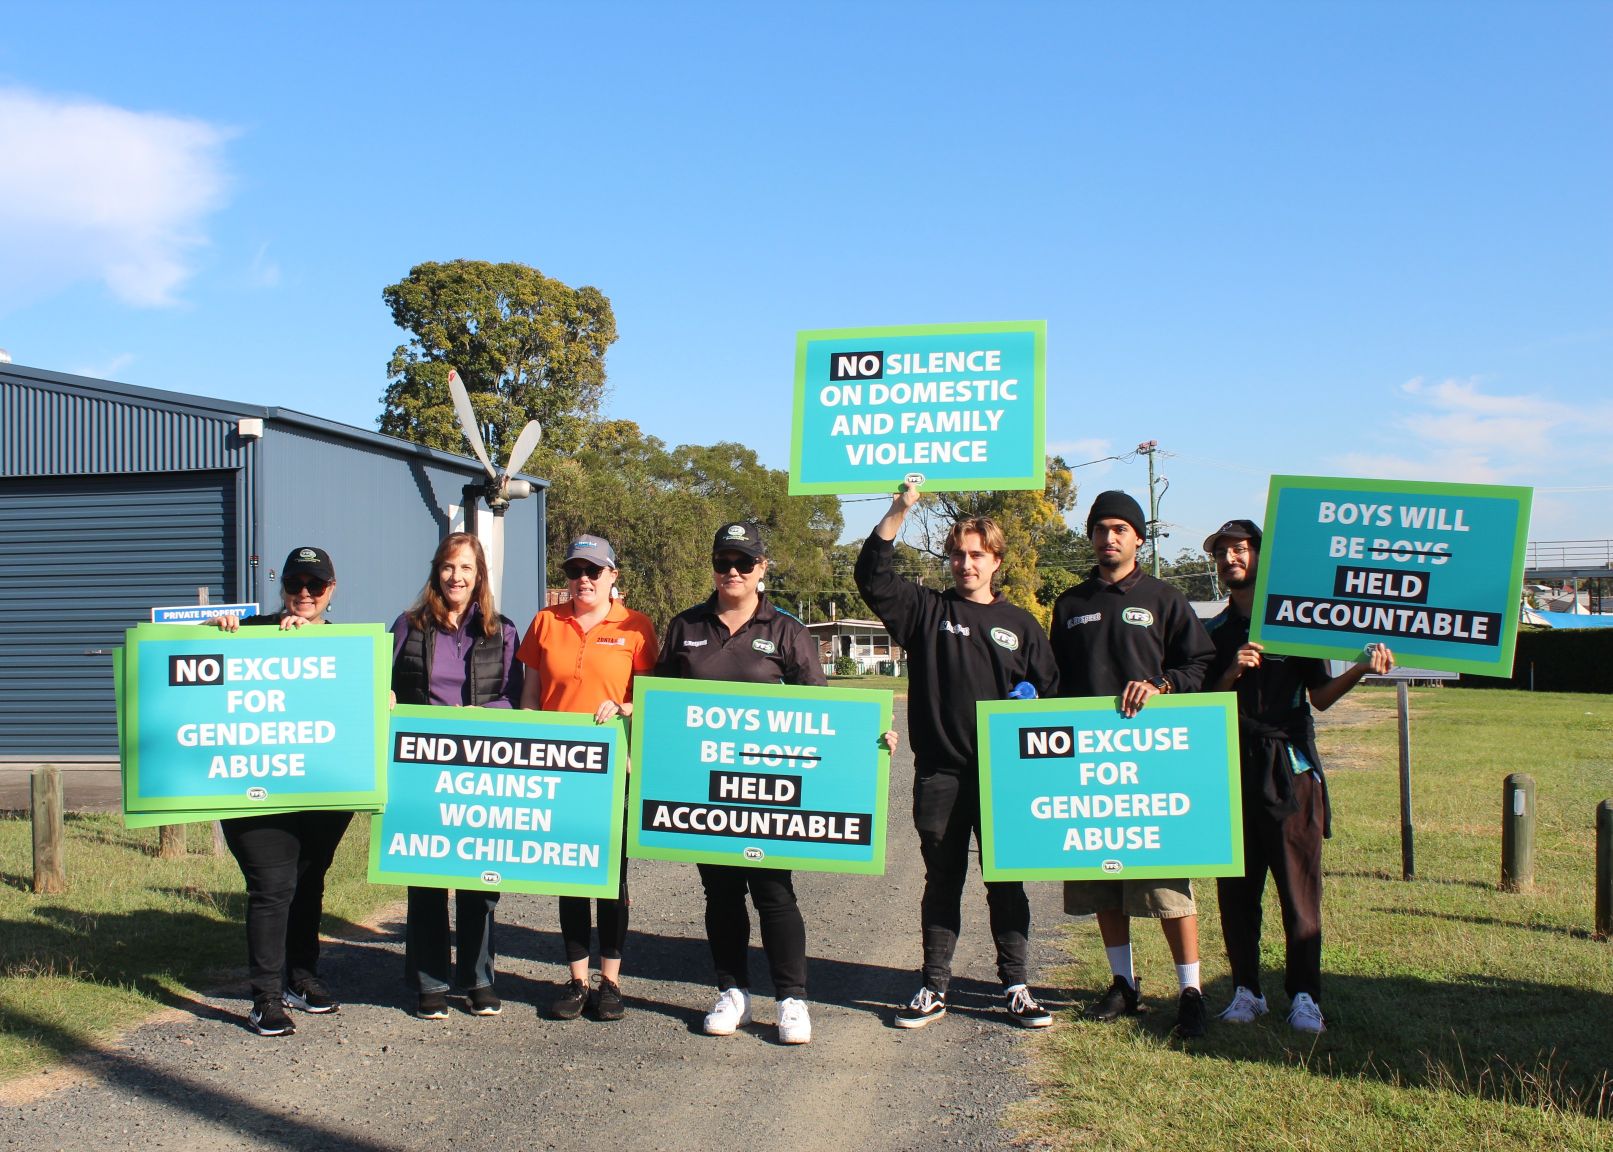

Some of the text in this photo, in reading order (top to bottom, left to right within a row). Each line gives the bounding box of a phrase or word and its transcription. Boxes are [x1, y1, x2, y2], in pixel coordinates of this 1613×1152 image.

[838, 350, 1001, 377] NO SILENCE
[820, 379, 1018, 407] ON DOMESTIC
[831, 410, 1004, 436] AND FAMILY
[846, 440, 987, 466] VIOLENCE
[1318, 501, 1470, 532] BOYS WILL
[1329, 536, 1449, 565] BE BOYS
[1345, 570, 1422, 598] HELD
[163, 608, 247, 620] PRIVATE PROPERTY
[1276, 600, 1489, 640] ACCOUNTABLE
[175, 656, 336, 682] NO EXCUSE
[227, 690, 286, 713] FOR
[177, 721, 336, 747] GENDERED
[686, 705, 836, 736] BOYS WILL
[399, 737, 602, 770] END VIOLENCE
[700, 740, 818, 769] BE BOYS
[1027, 727, 1189, 755] NO EXCUSE
[208, 753, 305, 779] ABUSE
[1080, 761, 1139, 786] FOR
[435, 771, 561, 800] AGAINST
[719, 775, 795, 802] HELD
[440, 804, 552, 832] WOMEN
[1030, 792, 1191, 819] GENDERED
[652, 805, 860, 840] ACCOUNTABLE
[388, 834, 600, 868] AND CHILDREN
[1063, 826, 1160, 851] ABUSE
